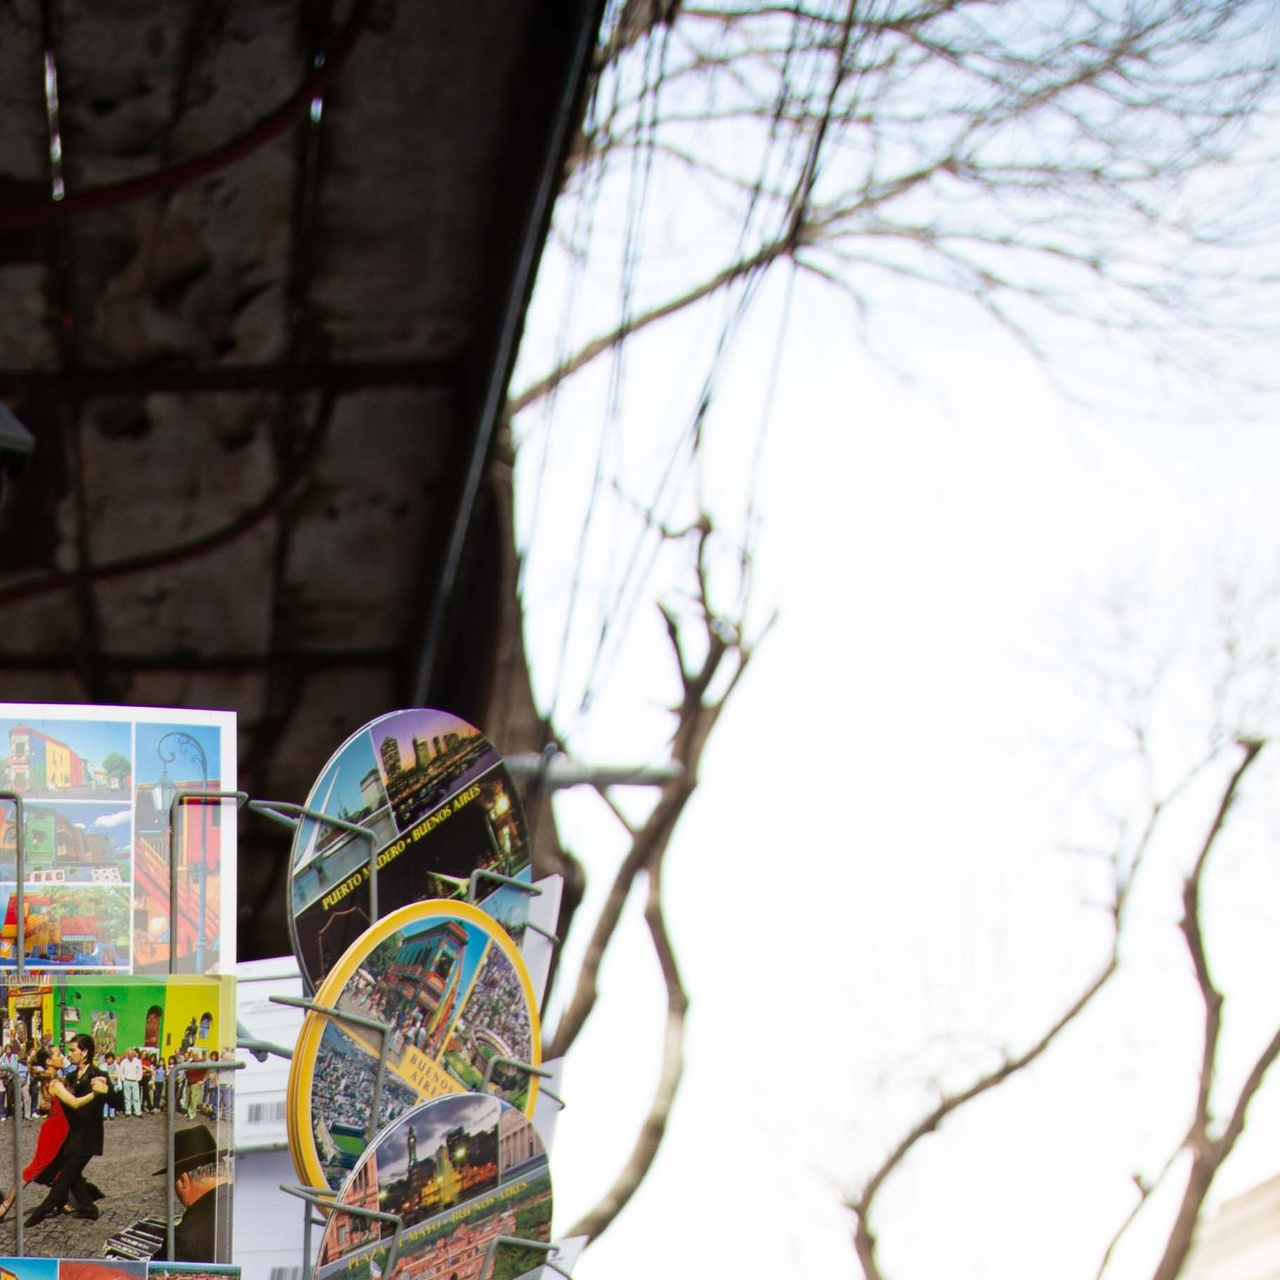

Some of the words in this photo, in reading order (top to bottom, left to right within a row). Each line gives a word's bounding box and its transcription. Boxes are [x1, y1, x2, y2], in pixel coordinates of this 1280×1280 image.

[321, 871, 363, 911] PUERTO
[411, 804, 452, 843] BUENOS
[452, 783, 482, 813] AIRES
[410, 1071, 441, 1098] AIRE
[407, 1221, 443, 1242] MAYO
